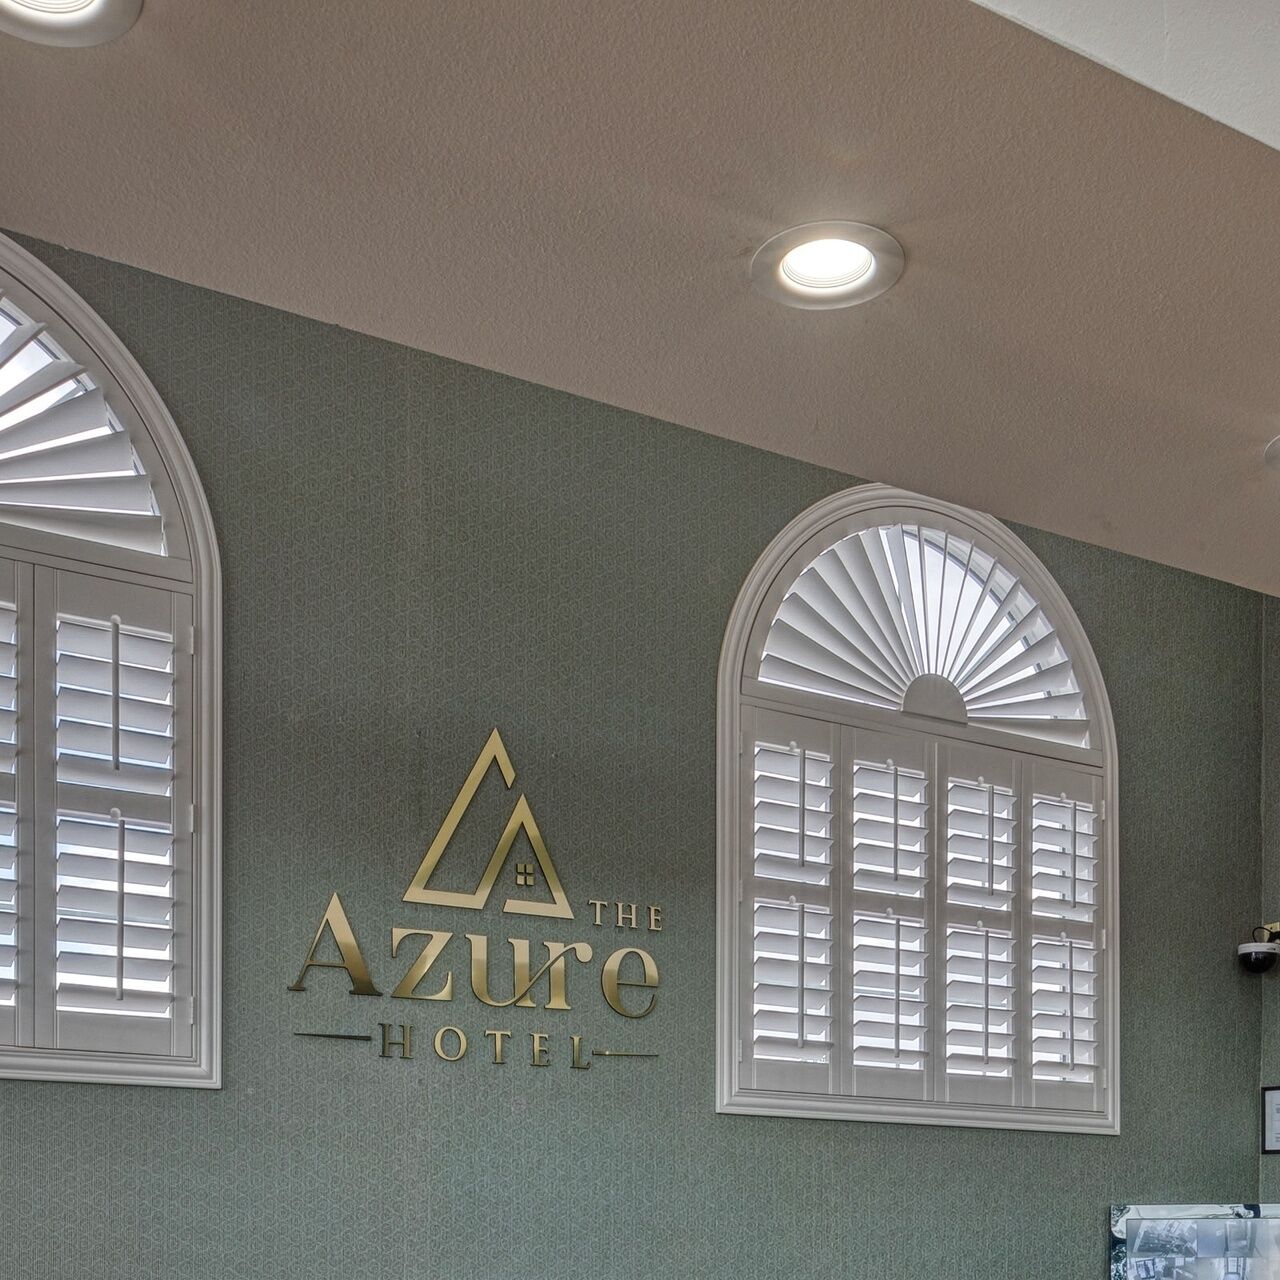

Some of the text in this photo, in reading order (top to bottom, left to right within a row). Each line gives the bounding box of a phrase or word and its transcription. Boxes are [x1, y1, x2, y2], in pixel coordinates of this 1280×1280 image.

[588, 899, 663, 931] THE
[287, 891, 661, 1019] Azure
[378, 1022, 591, 1070] HOTEL
